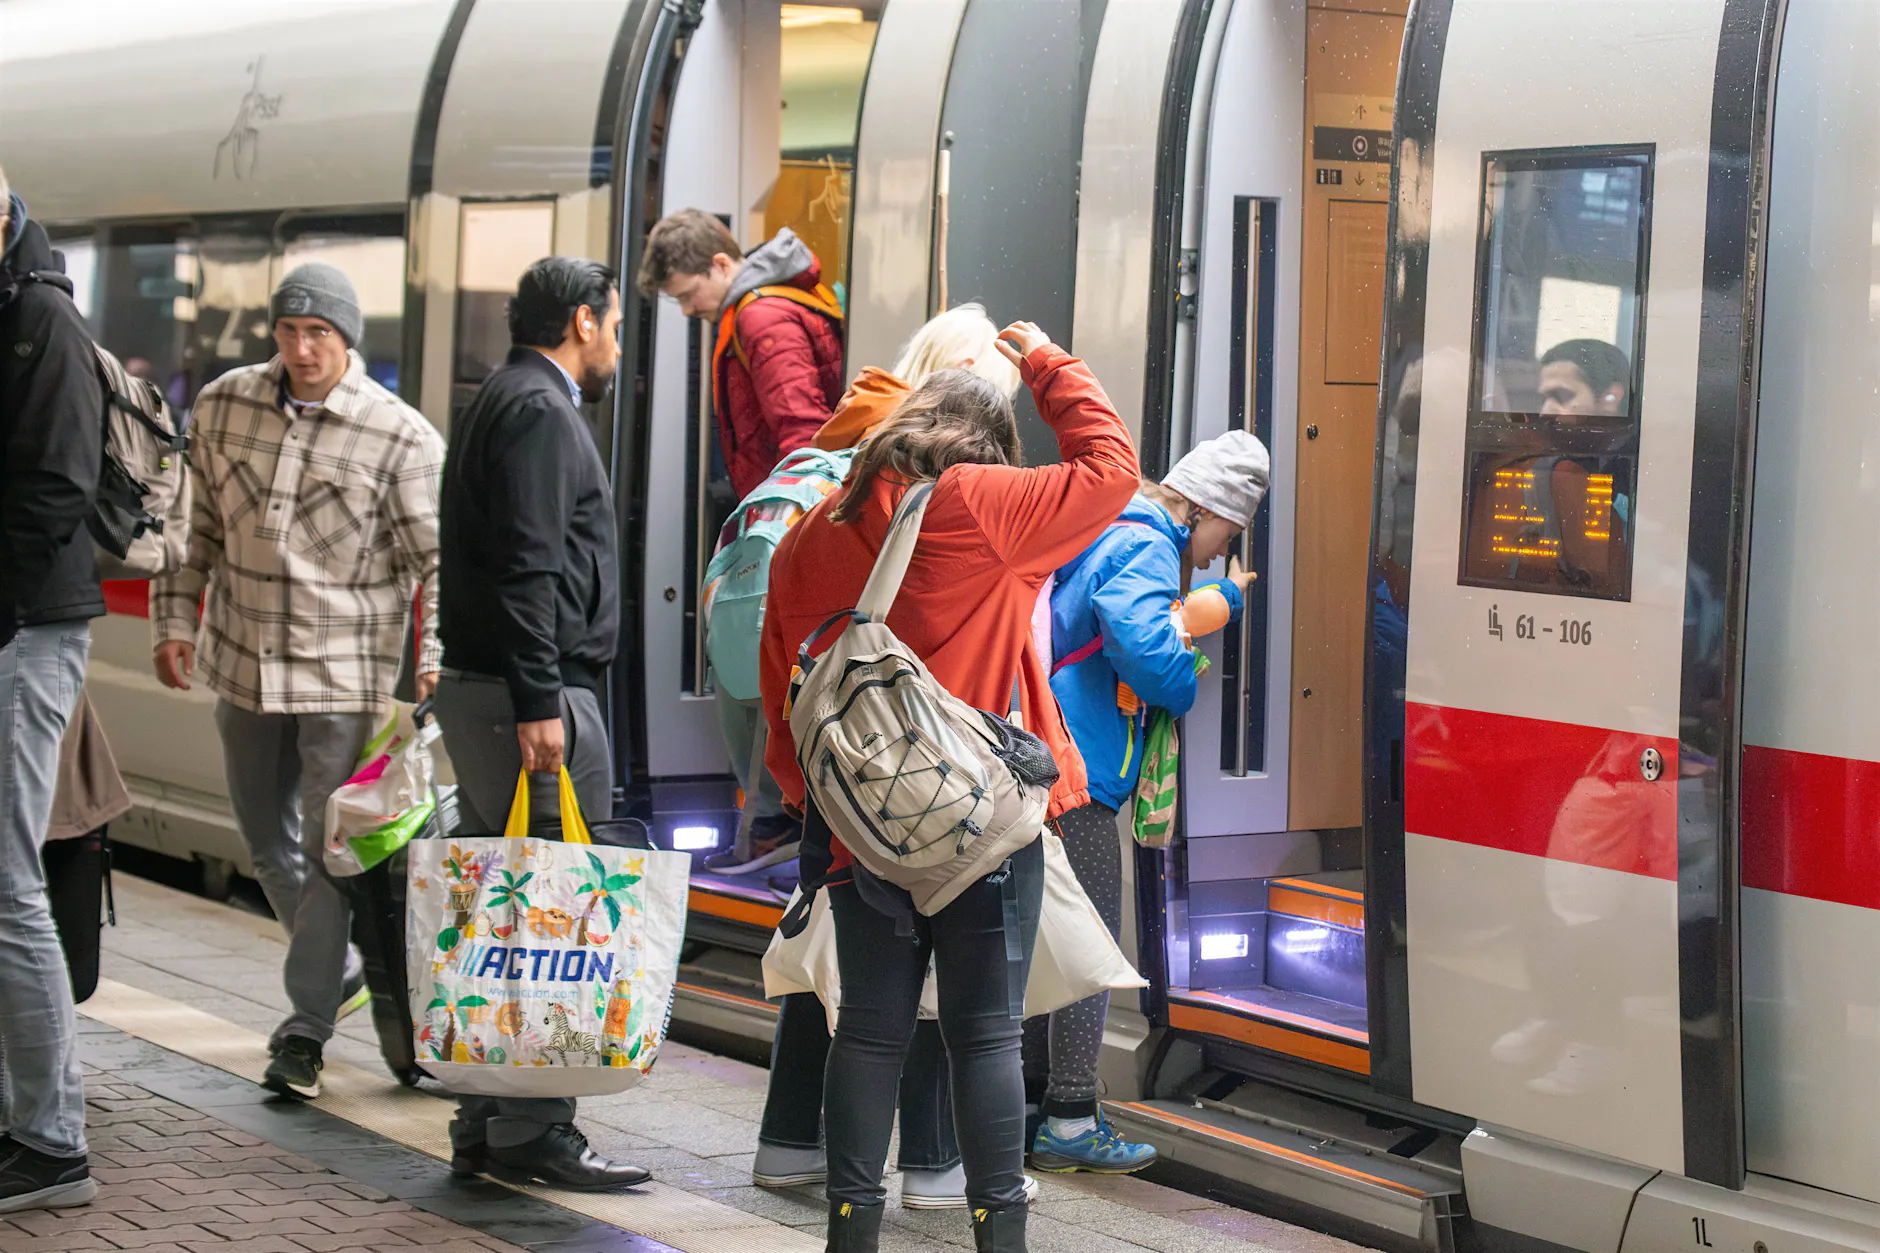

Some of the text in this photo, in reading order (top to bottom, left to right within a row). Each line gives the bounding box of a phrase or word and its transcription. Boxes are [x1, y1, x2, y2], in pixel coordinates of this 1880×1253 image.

[1515, 614, 1535, 639] 61
[1559, 619, 1592, 646] 106
[477, 947, 615, 983] ACTION
[1692, 1216, 1713, 1248] 1L
